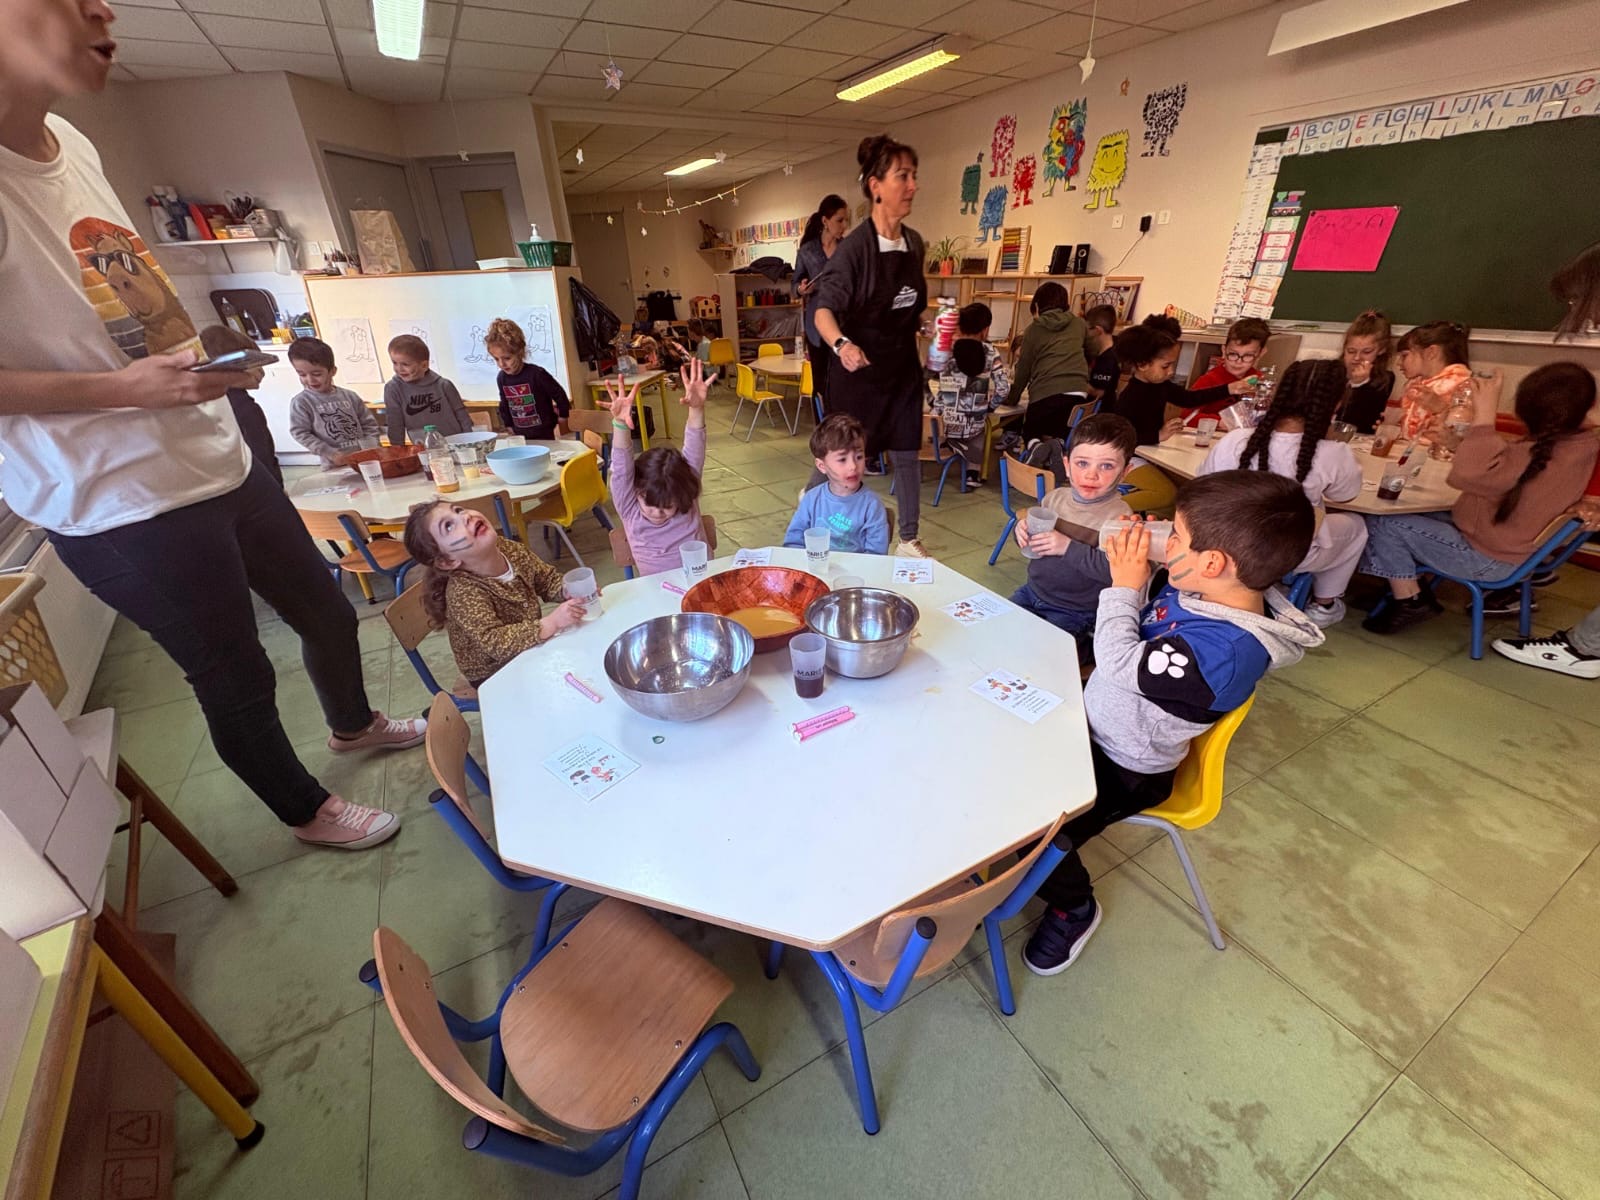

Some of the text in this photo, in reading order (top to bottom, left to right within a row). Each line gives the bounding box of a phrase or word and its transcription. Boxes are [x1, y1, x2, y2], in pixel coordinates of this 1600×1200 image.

[1290, 79, 1596, 139] A B C D E F G H I J K L M N O
[410, 392, 434, 406] NIKE
[430, 402, 441, 414] SB
